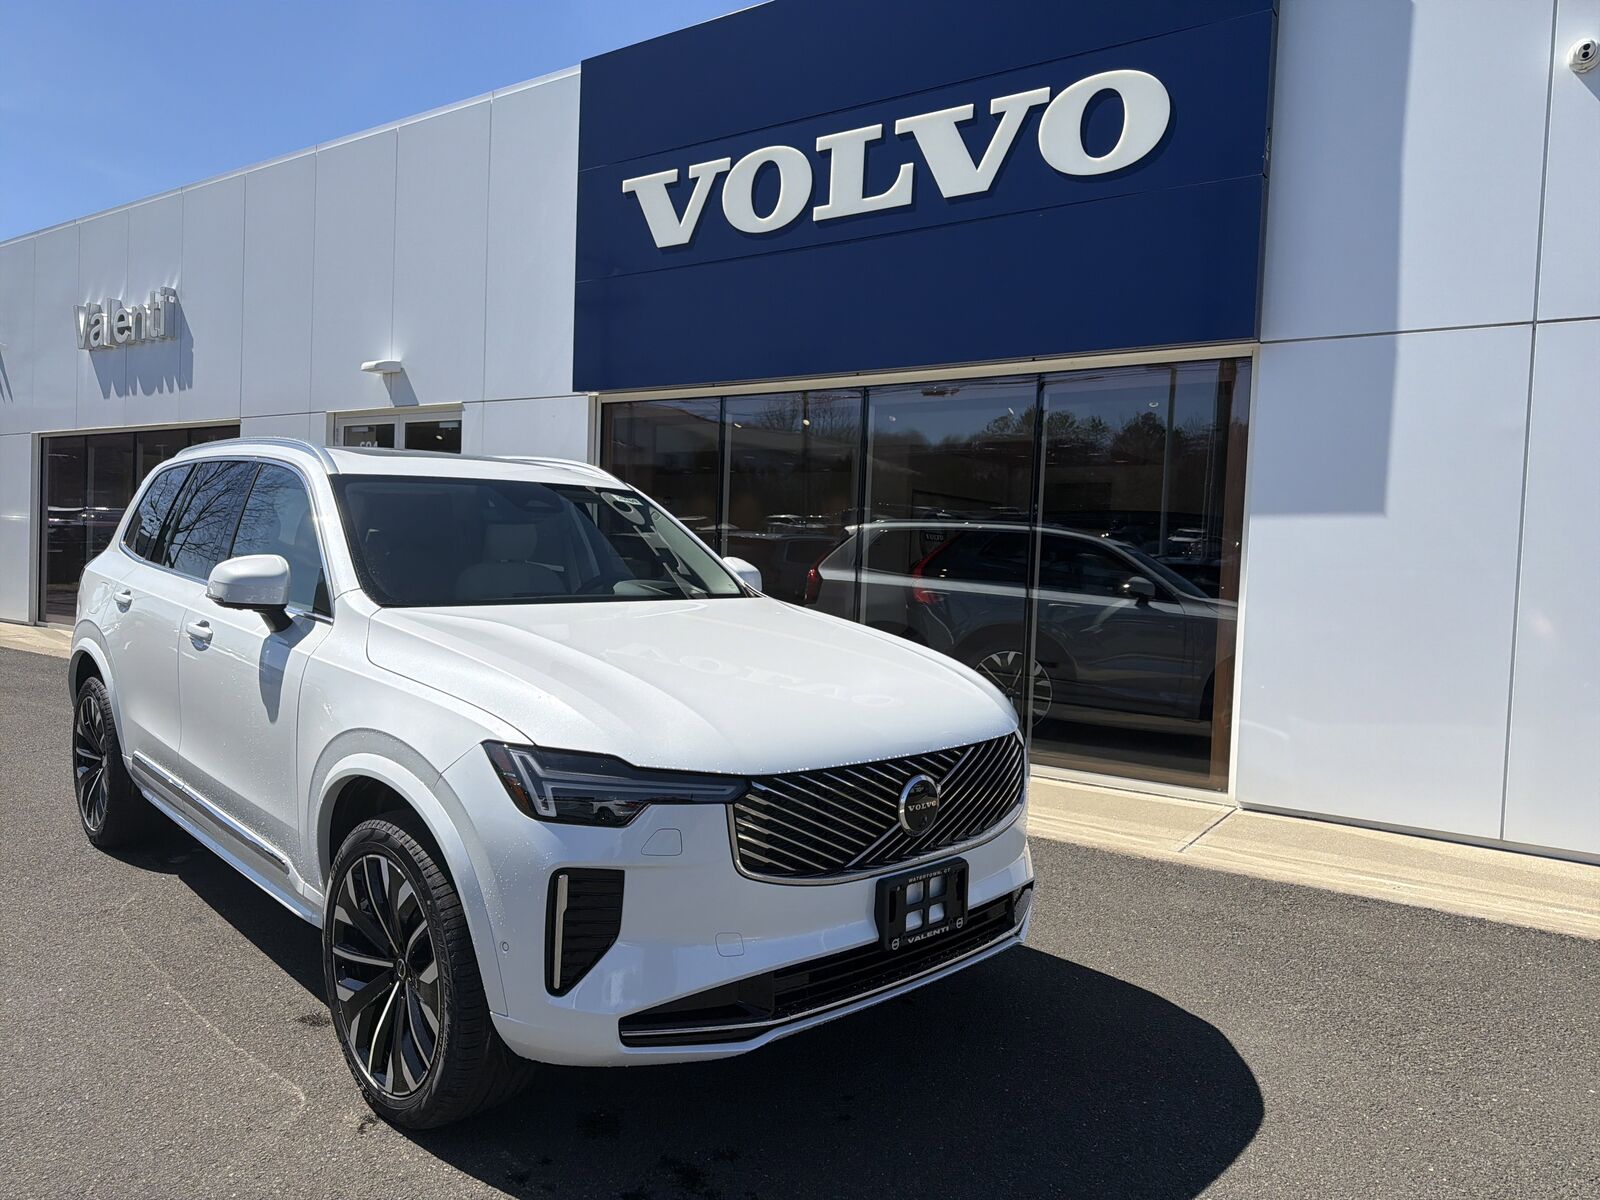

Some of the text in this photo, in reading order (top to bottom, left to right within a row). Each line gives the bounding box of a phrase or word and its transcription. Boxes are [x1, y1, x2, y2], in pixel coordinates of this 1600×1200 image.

[622, 69, 1171, 248] VOLVO
[73, 287, 175, 350] Valenti
[908, 800, 937, 812] VOLVO
[907, 926, 949, 944] VALENTI
